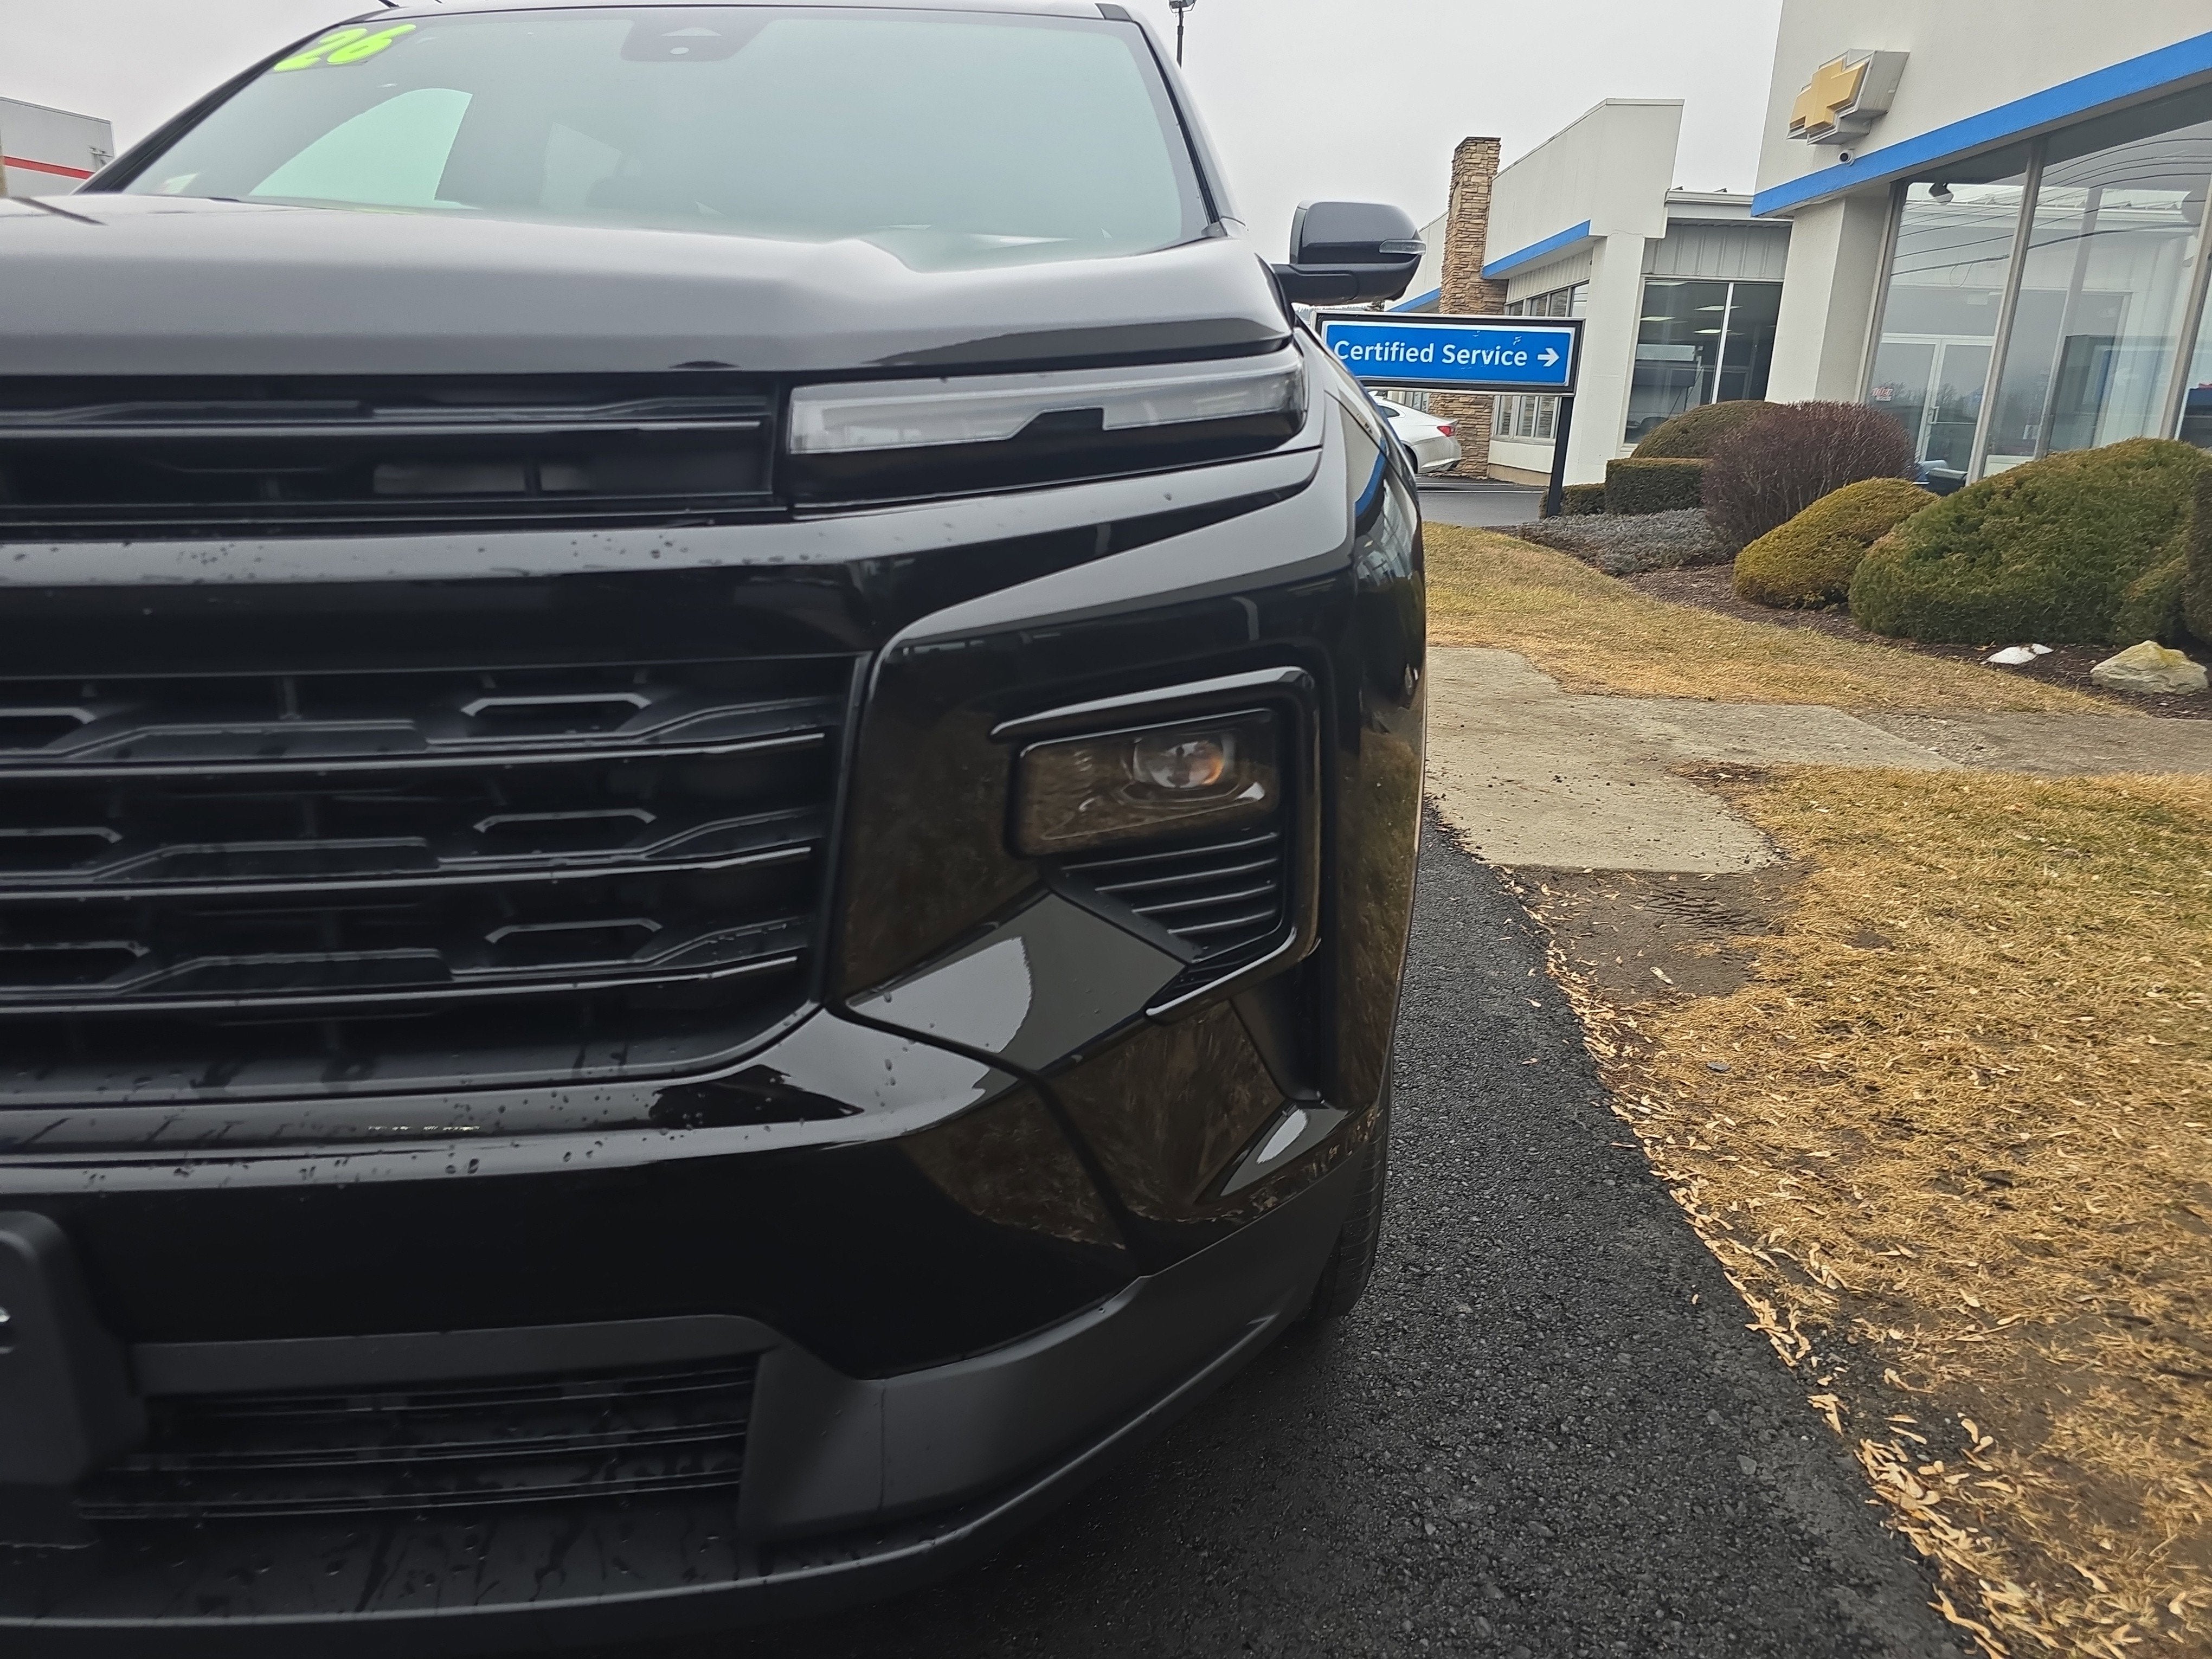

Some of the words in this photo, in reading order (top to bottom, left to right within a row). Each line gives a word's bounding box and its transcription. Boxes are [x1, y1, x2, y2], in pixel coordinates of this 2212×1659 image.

[273, 24, 416, 72] 26
[1334, 340, 1435, 363] Certified
[1442, 344, 1528, 366] Service
